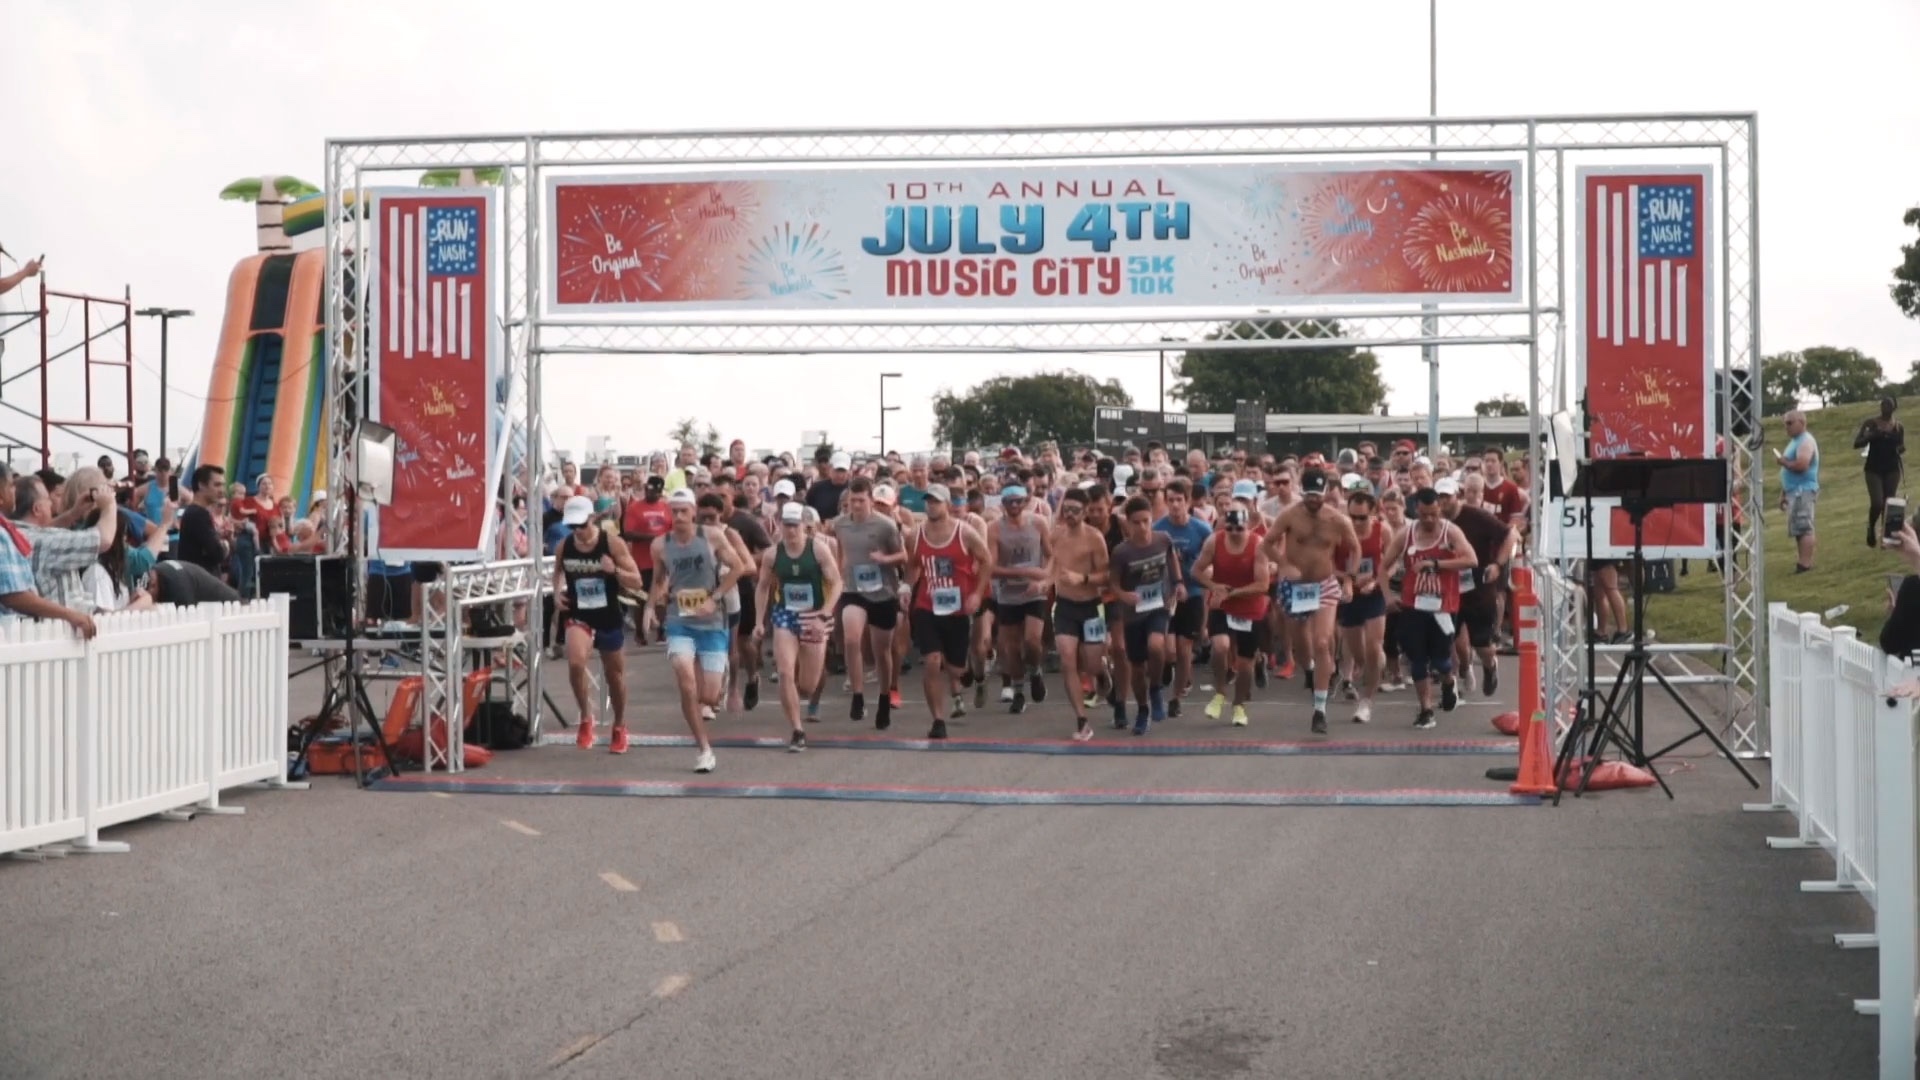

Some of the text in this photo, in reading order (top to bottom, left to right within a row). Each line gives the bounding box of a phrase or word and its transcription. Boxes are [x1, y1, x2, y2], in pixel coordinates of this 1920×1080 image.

[709, 188, 722, 204] Be
[887, 178, 1175, 200] 10TH ANNUAL
[699, 203, 736, 221] Healthy
[1649, 198, 1684, 222] RUN
[436, 219, 468, 242] RUN
[861, 201, 1190, 256] JULY 4TH
[1450, 223, 1468, 240] Be
[1650, 225, 1683, 244] NASH
[605, 233, 623, 254] Be
[1251, 243, 1267, 261] Be
[1435, 238, 1490, 263] Nashville
[438, 245, 467, 262] NASH
[592, 249, 642, 281] Original
[1127, 255, 1175, 274] 5K
[1239, 260, 1285, 284] Original
[1127, 276, 1175, 295] 10K
[1644, 374, 1658, 391] Be
[431, 386, 444, 401] Be
[1635, 390, 1671, 408] Healthy
[423, 400, 456, 417] Healthy
[1100, 409, 1123, 420] HOME
[1604, 427, 1618, 444] Be
[1595, 438, 1631, 460] Original
